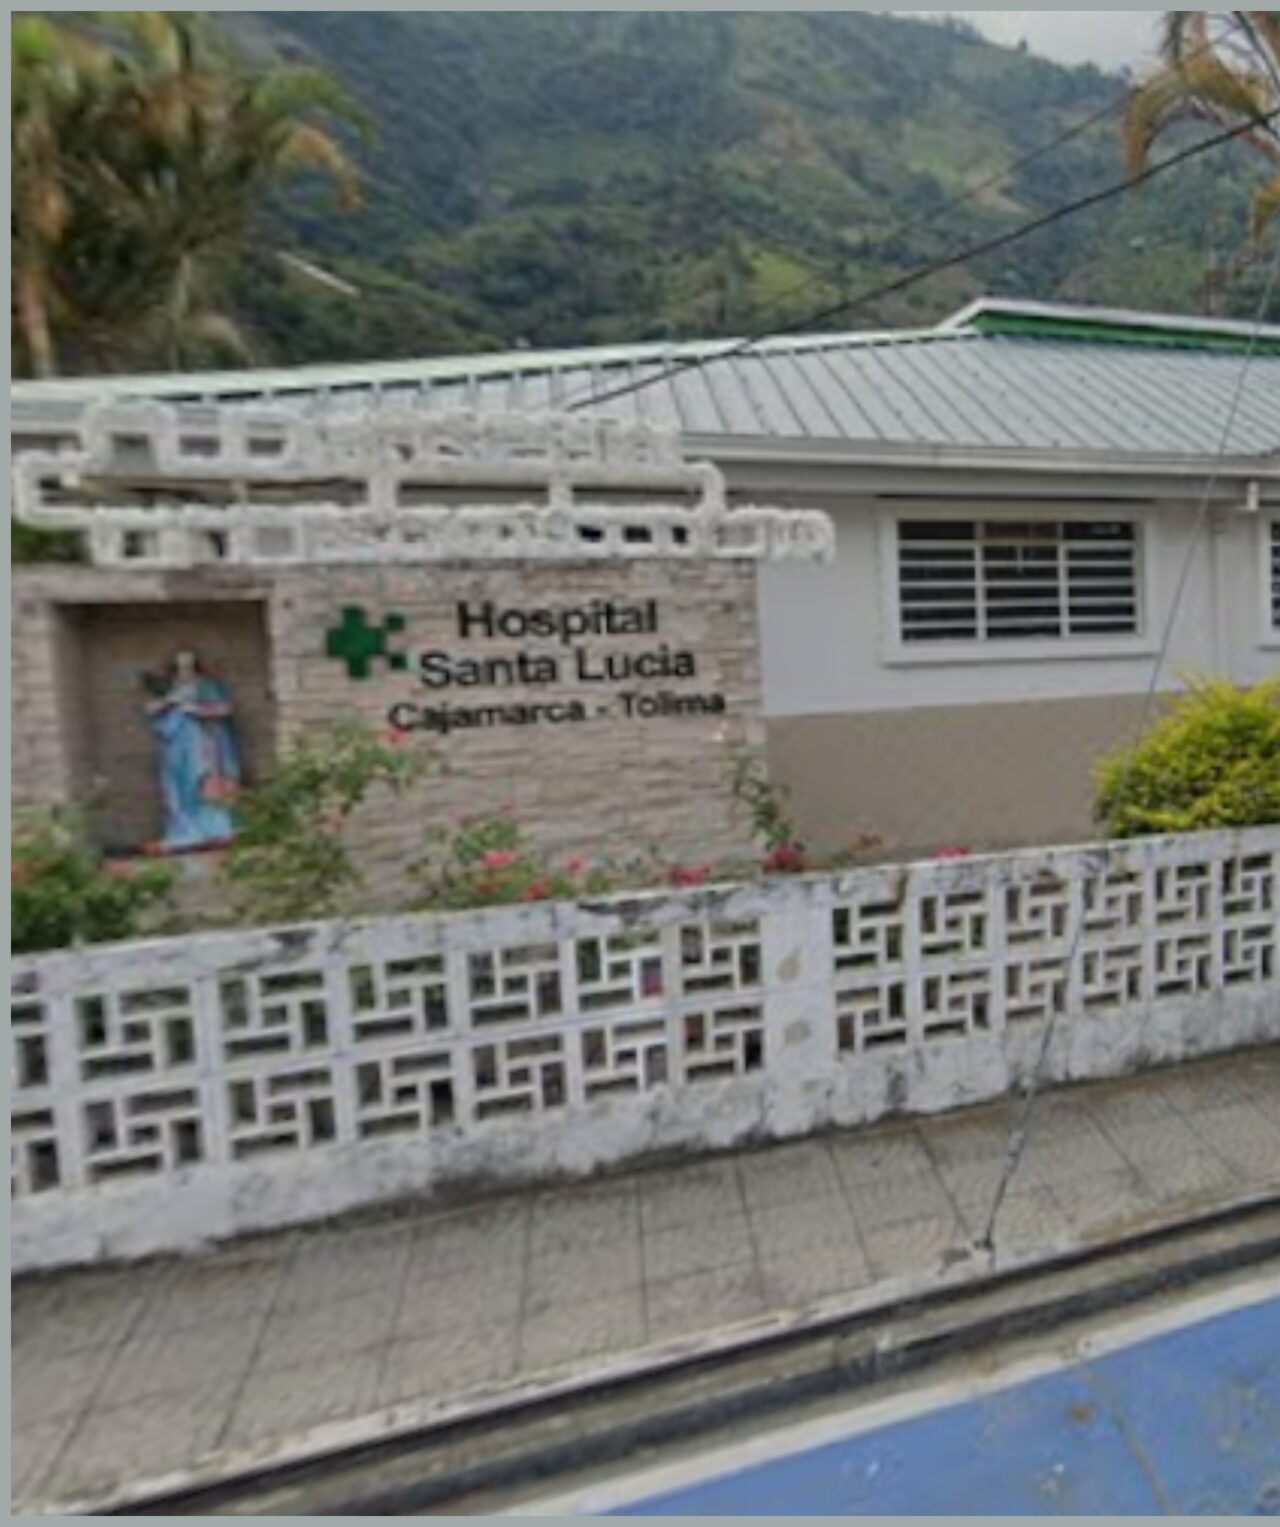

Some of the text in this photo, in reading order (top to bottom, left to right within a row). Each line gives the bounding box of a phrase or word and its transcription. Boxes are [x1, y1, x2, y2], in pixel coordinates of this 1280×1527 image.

[457, 599, 658, 644] Hospital
[420, 645, 697, 688] Santa Lucia
[388, 701, 586, 735] Cajamarca
[616, 690, 727, 718] Tolima
